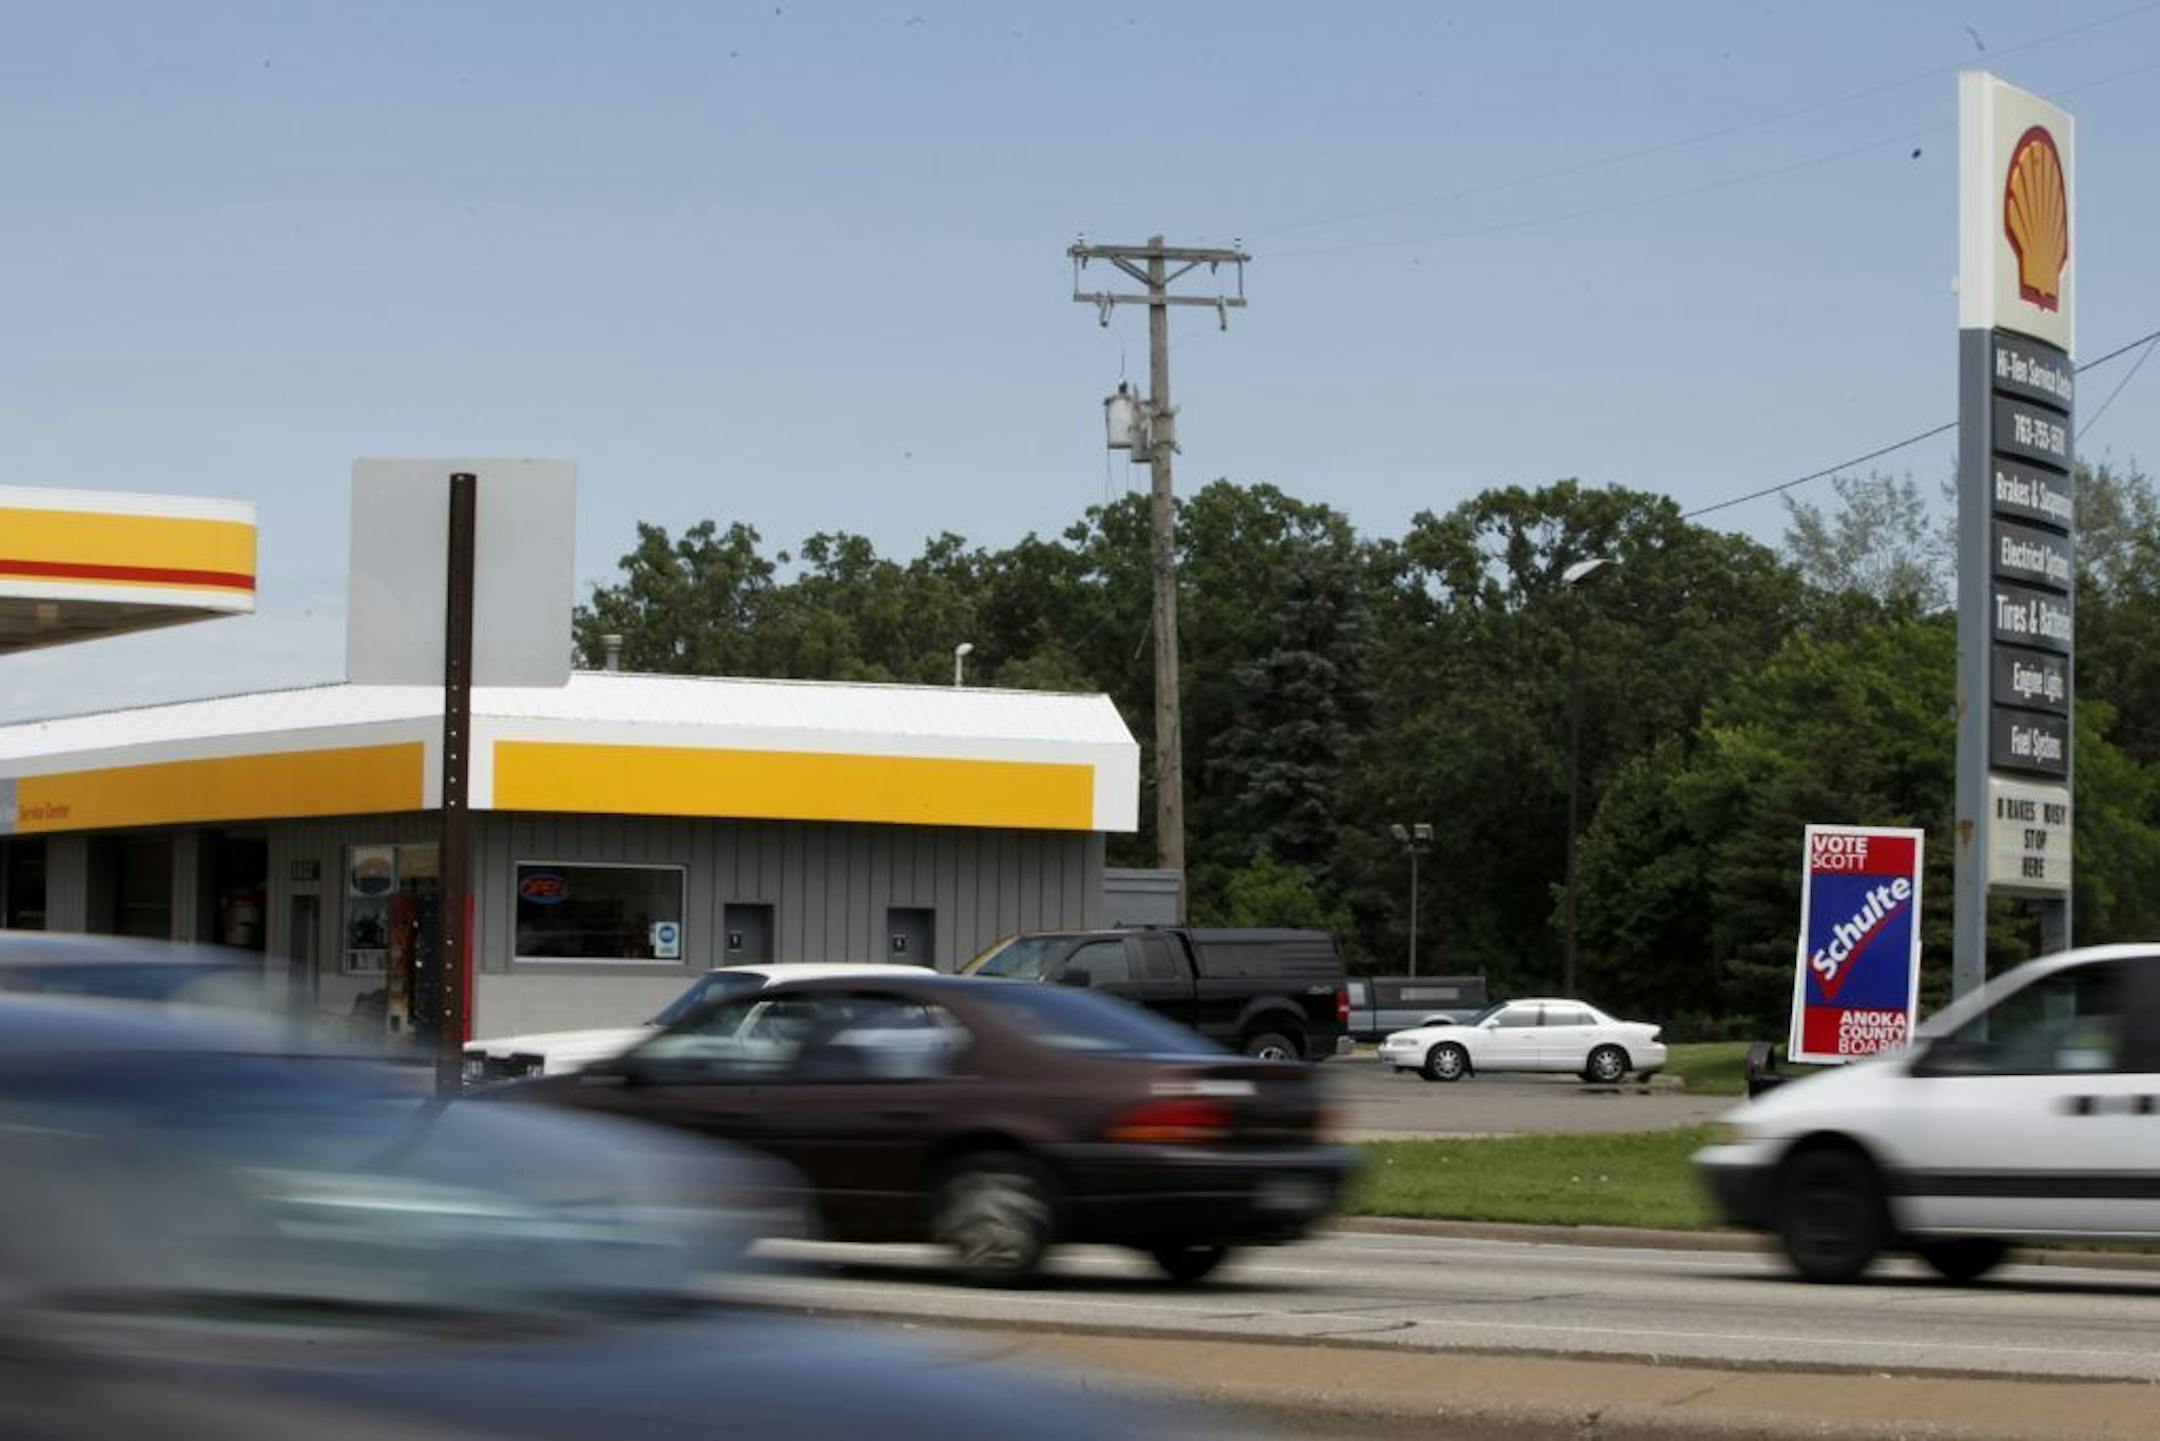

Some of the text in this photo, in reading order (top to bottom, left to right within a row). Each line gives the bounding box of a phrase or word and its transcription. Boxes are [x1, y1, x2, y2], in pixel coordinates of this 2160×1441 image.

[1996, 472, 2029, 506] Brakes
[2031, 479, 2038, 508] &
[2001, 536, 2044, 573] Electrical
[1996, 594, 2027, 632] Tires
[2029, 599, 2037, 635] &
[2013, 662, 2042, 698] Engine
[2011, 725, 2031, 755] Fuel
[1812, 835, 1868, 854] VOTE
[2024, 829, 2046, 850] STOP
[1811, 852, 1867, 870] SCOTT
[2022, 856, 2044, 878] HERE
[1812, 877, 1911, 980] Schulte
[1840, 1010, 1906, 1028] ANOKA
[1838, 1025, 1906, 1041] COUNTY
